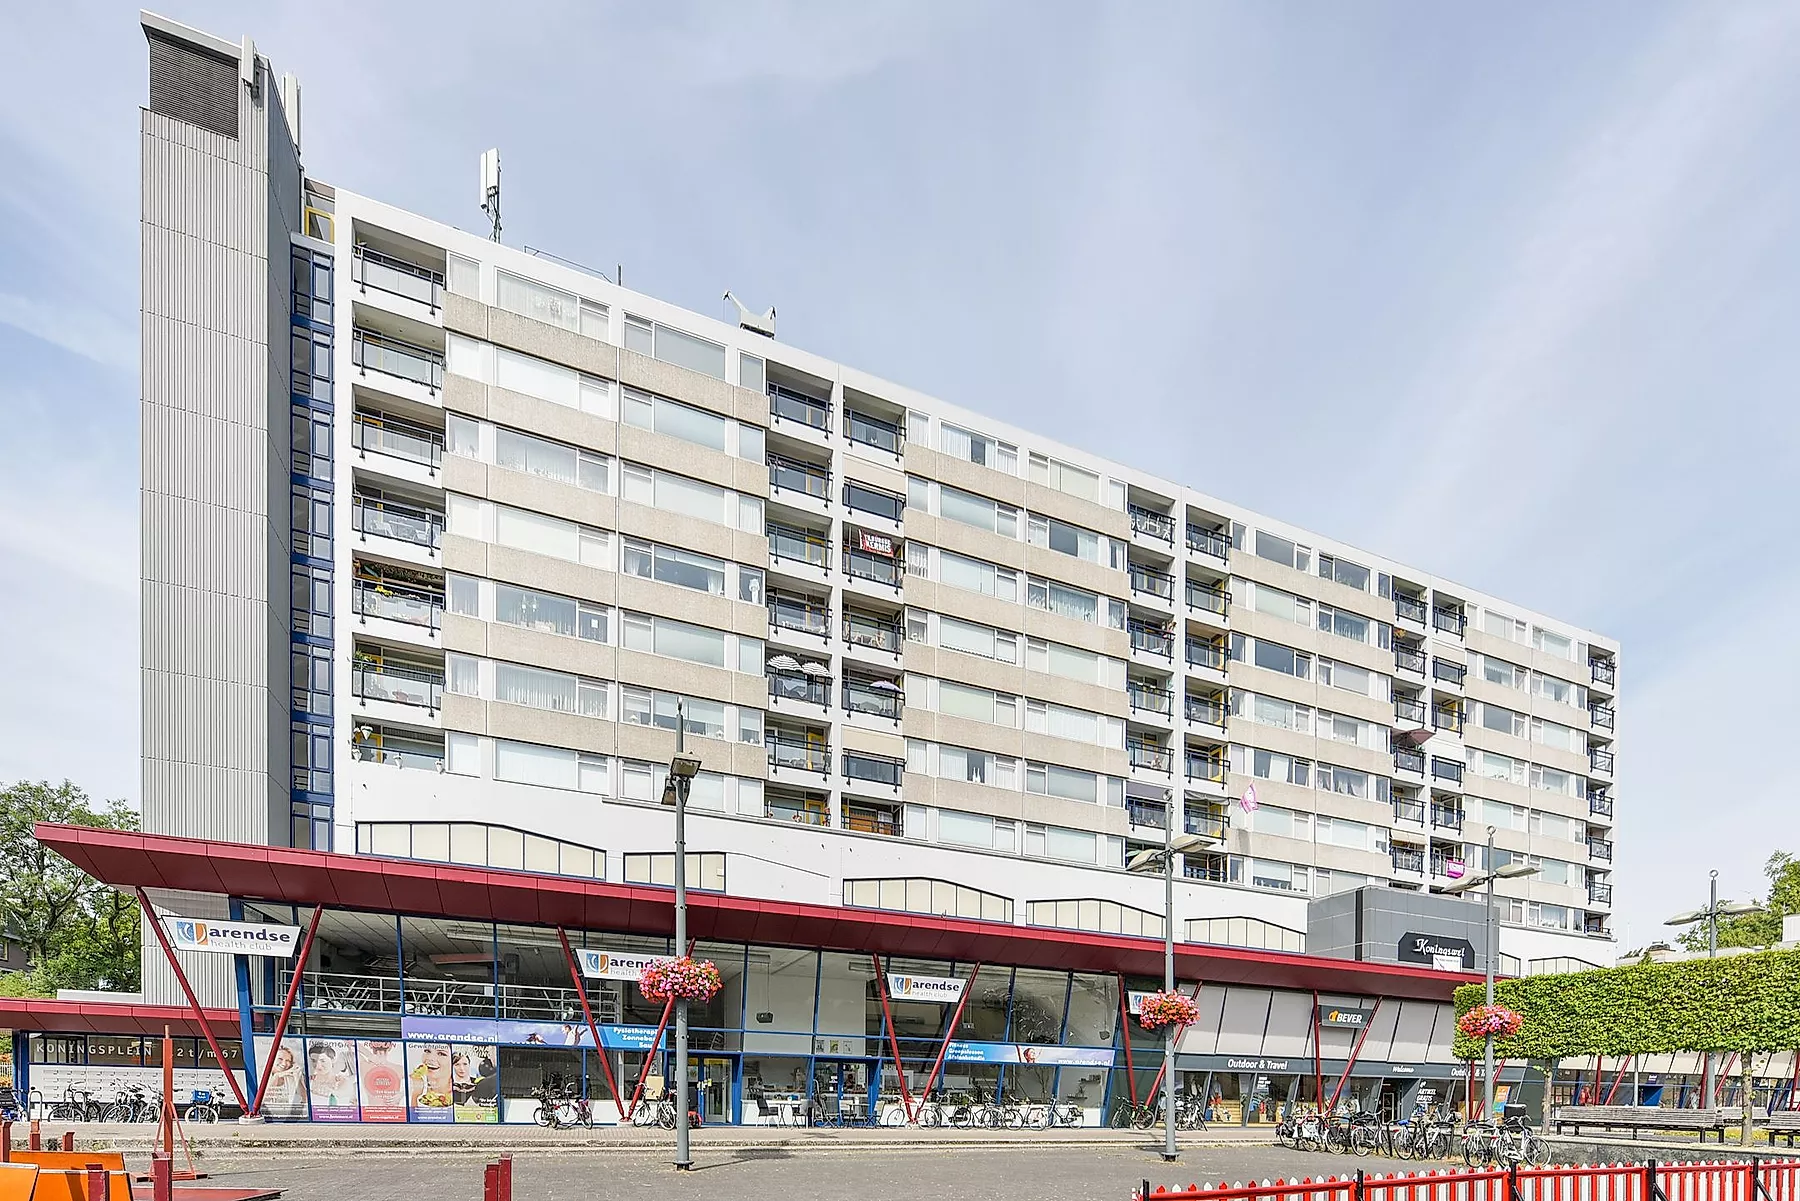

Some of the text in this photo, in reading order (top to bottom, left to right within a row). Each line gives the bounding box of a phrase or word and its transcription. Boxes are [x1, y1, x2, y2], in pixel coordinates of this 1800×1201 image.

[208, 928, 291, 942] arendse
[210, 939, 272, 951] health club
[610, 968, 637, 977] health
[912, 981, 960, 991] arendse
[1336, 1013, 1363, 1024] BEVER
[407, 1031, 498, 1043] www.arendse.nl
[36, 1043, 152, 1056] KONINGSPLEIN
[221, 1050, 238, 1058] 67
[1228, 1059, 1288, 1070] Outdoor & Travel
